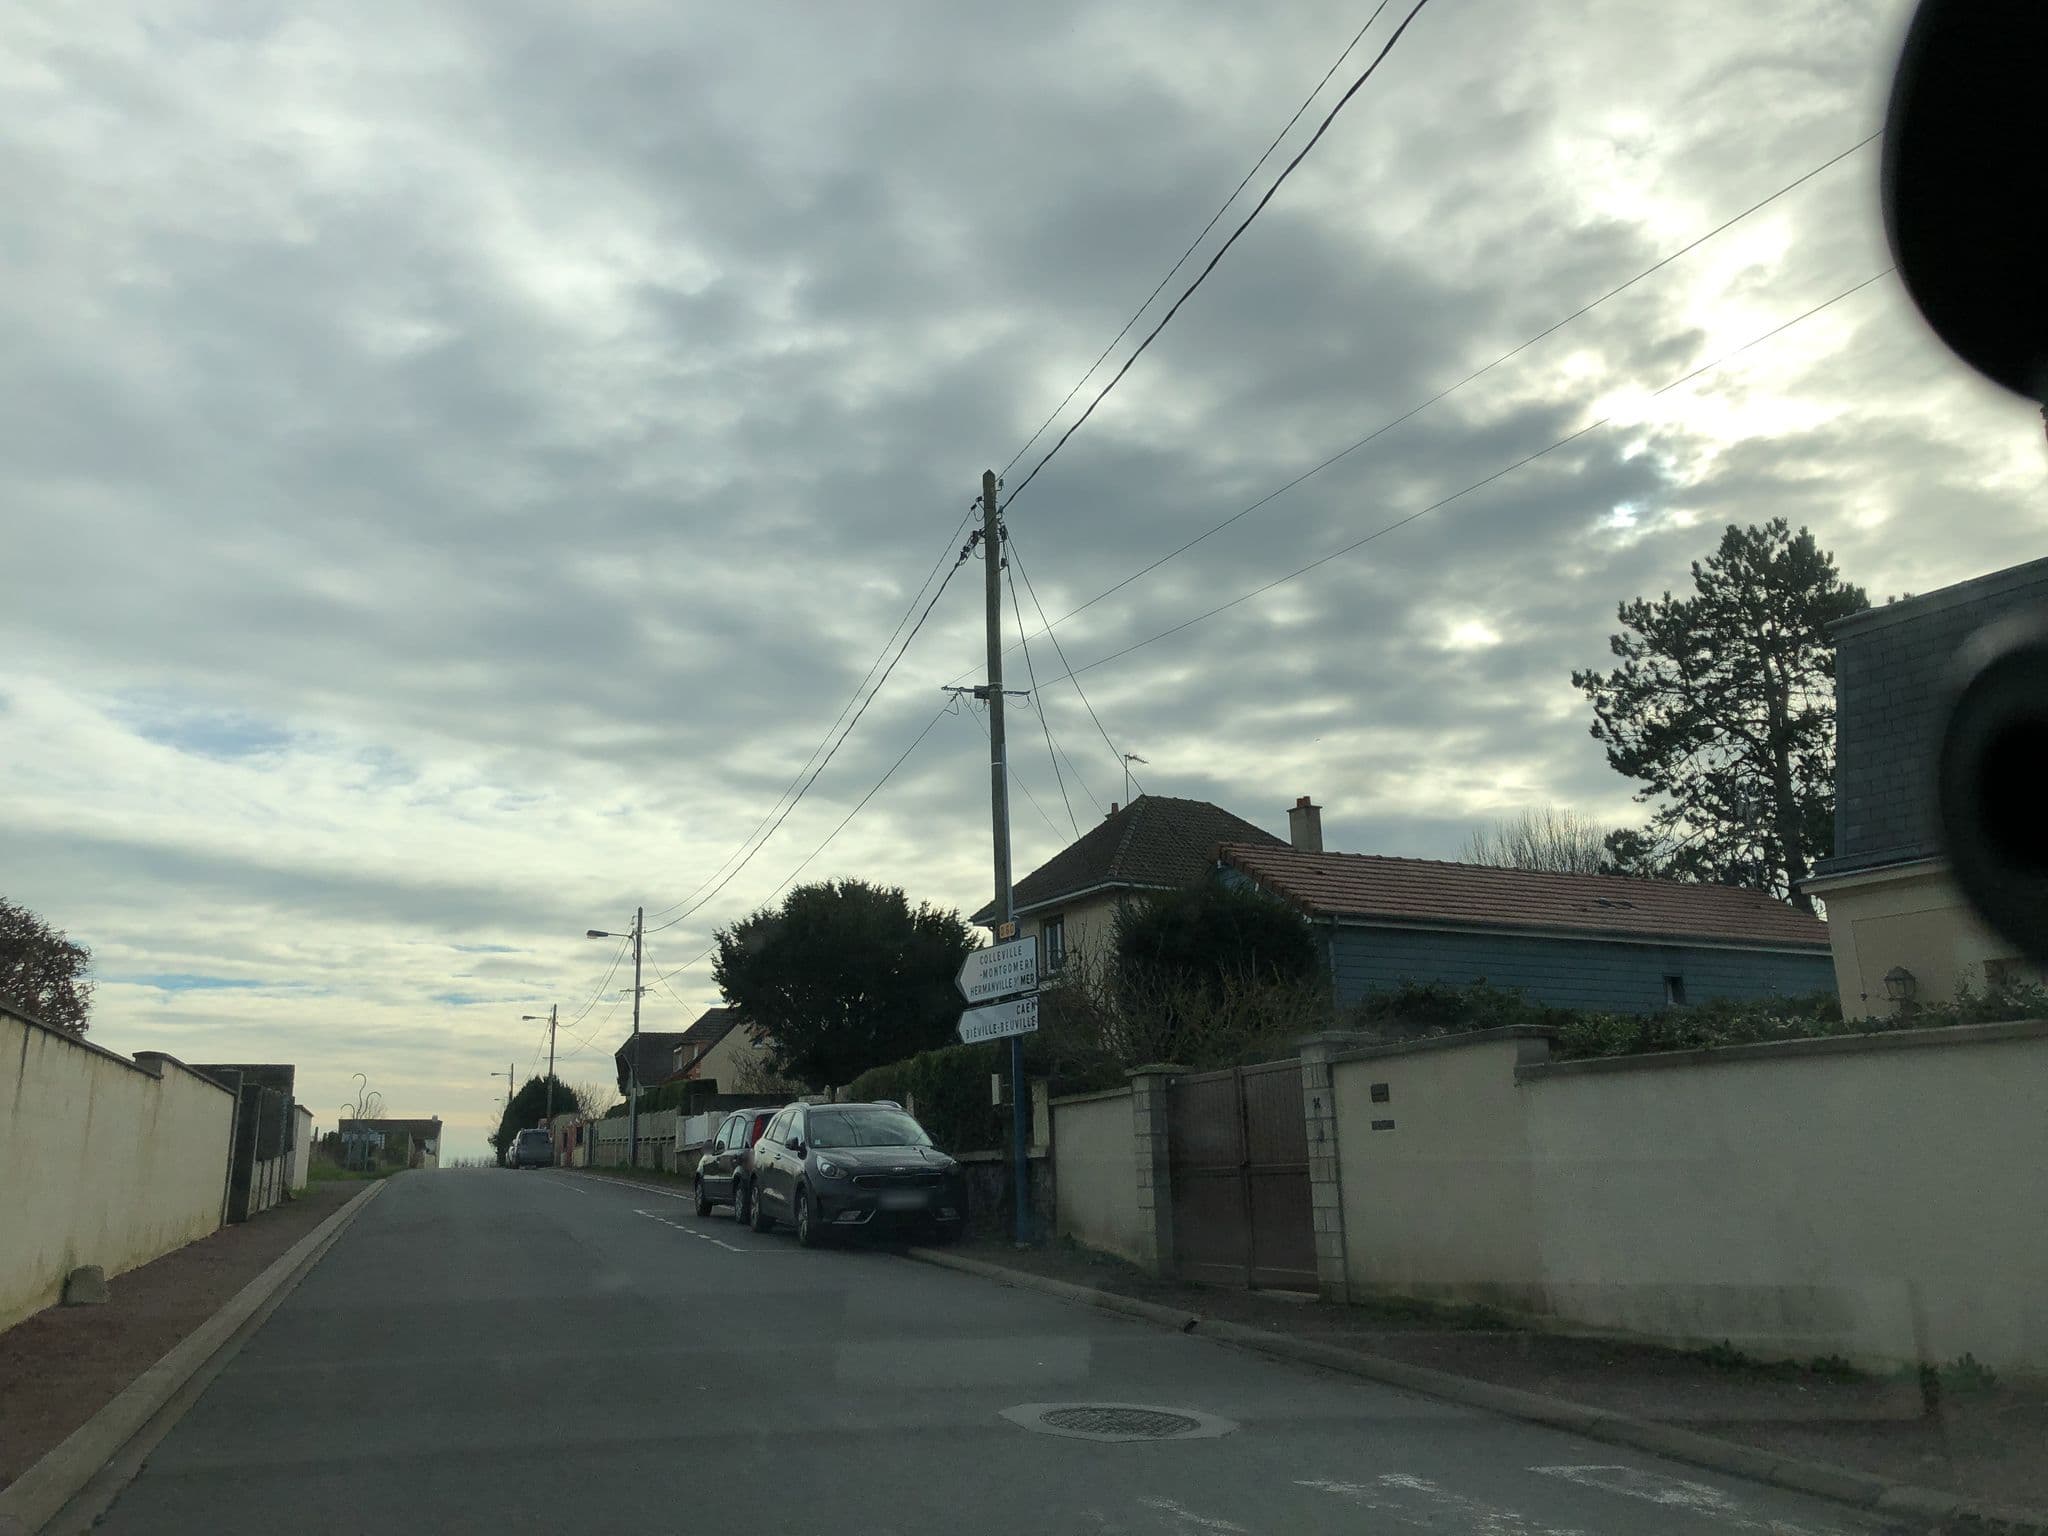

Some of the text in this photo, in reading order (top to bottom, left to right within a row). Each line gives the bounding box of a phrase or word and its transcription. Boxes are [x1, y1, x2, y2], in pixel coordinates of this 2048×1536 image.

[980, 945, 1022, 966] COLLEVILLE
[970, 977, 1013, 997] HERMANVILLE
[1020, 973, 1036, 986] MER
[1016, 1001, 1036, 1015] CAEN
